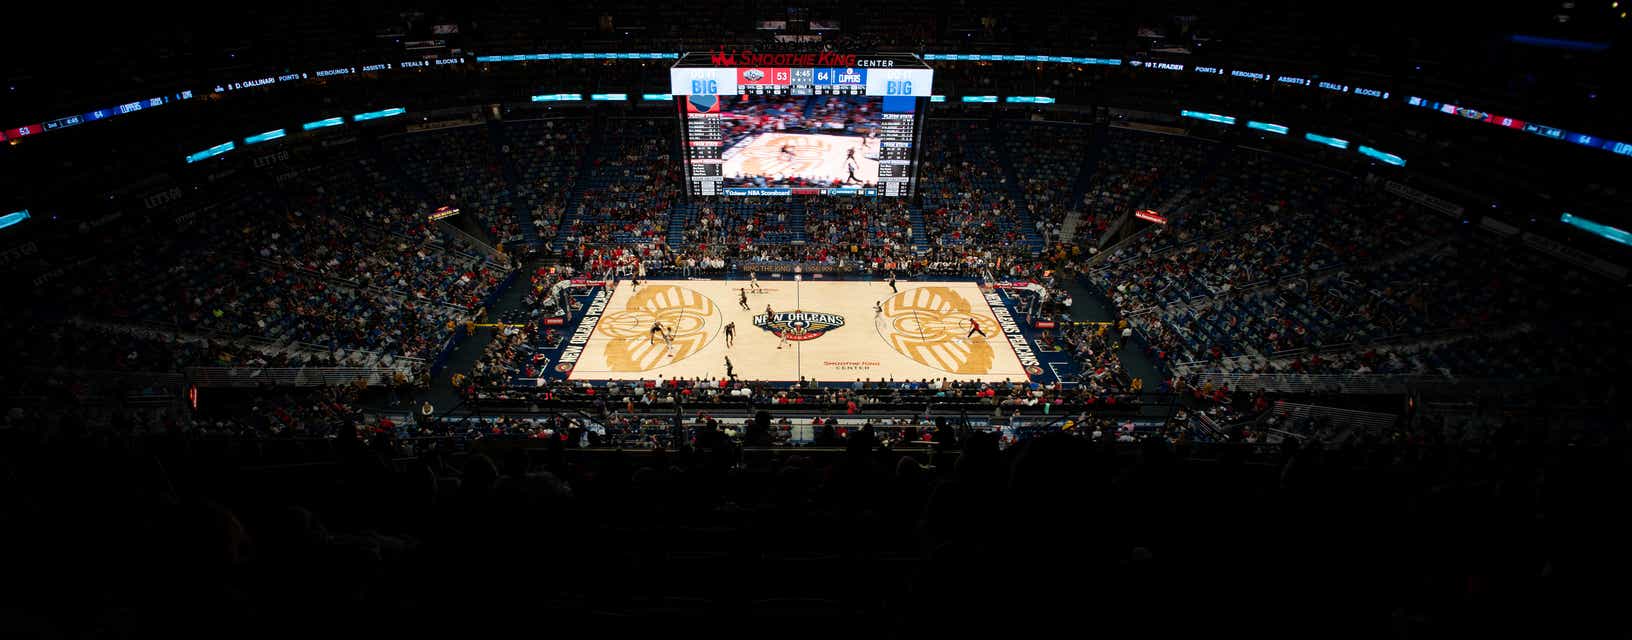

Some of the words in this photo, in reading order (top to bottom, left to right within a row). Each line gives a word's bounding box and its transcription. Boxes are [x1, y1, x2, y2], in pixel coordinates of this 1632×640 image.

[740, 50, 816, 66] SMOOTHIE
[857, 59, 894, 67] CENTER
[243, 77, 276, 88] GALLINARI
[279, 73, 300, 82] POINTS
[316, 68, 349, 77] REBOUNDS
[363, 63, 386, 72] ASSISTS
[401, 60, 423, 68] STEALS
[776, 72, 787, 80] 53
[818, 72, 829, 81] 64
[1158, 63, 1184, 71] FRAZIER
[1195, 66, 1217, 74] POINTS
[1231, 70, 1263, 80] REBOUNDS
[1278, 76, 1304, 85] ASSISTS
[1318, 81, 1341, 91] STEALS
[1354, 87, 1381, 97] BLOCKS
[692, 79, 718, 94] BIG
[887, 80, 912, 95] BIG
[19, 127, 30, 136] 53
[94, 110, 104, 119] 64
[120, 101, 142, 114] CLIPPERS
[1502, 117, 1513, 127] 53
[1579, 135, 1592, 144] 64
[788, 313, 844, 326] ORLEANS
[570, 316, 599, 344] ORLEANS
[992, 306, 1020, 333] ORLEANS
[1006, 334, 1040, 367] PELICANS
[559, 345, 583, 363] NEW
